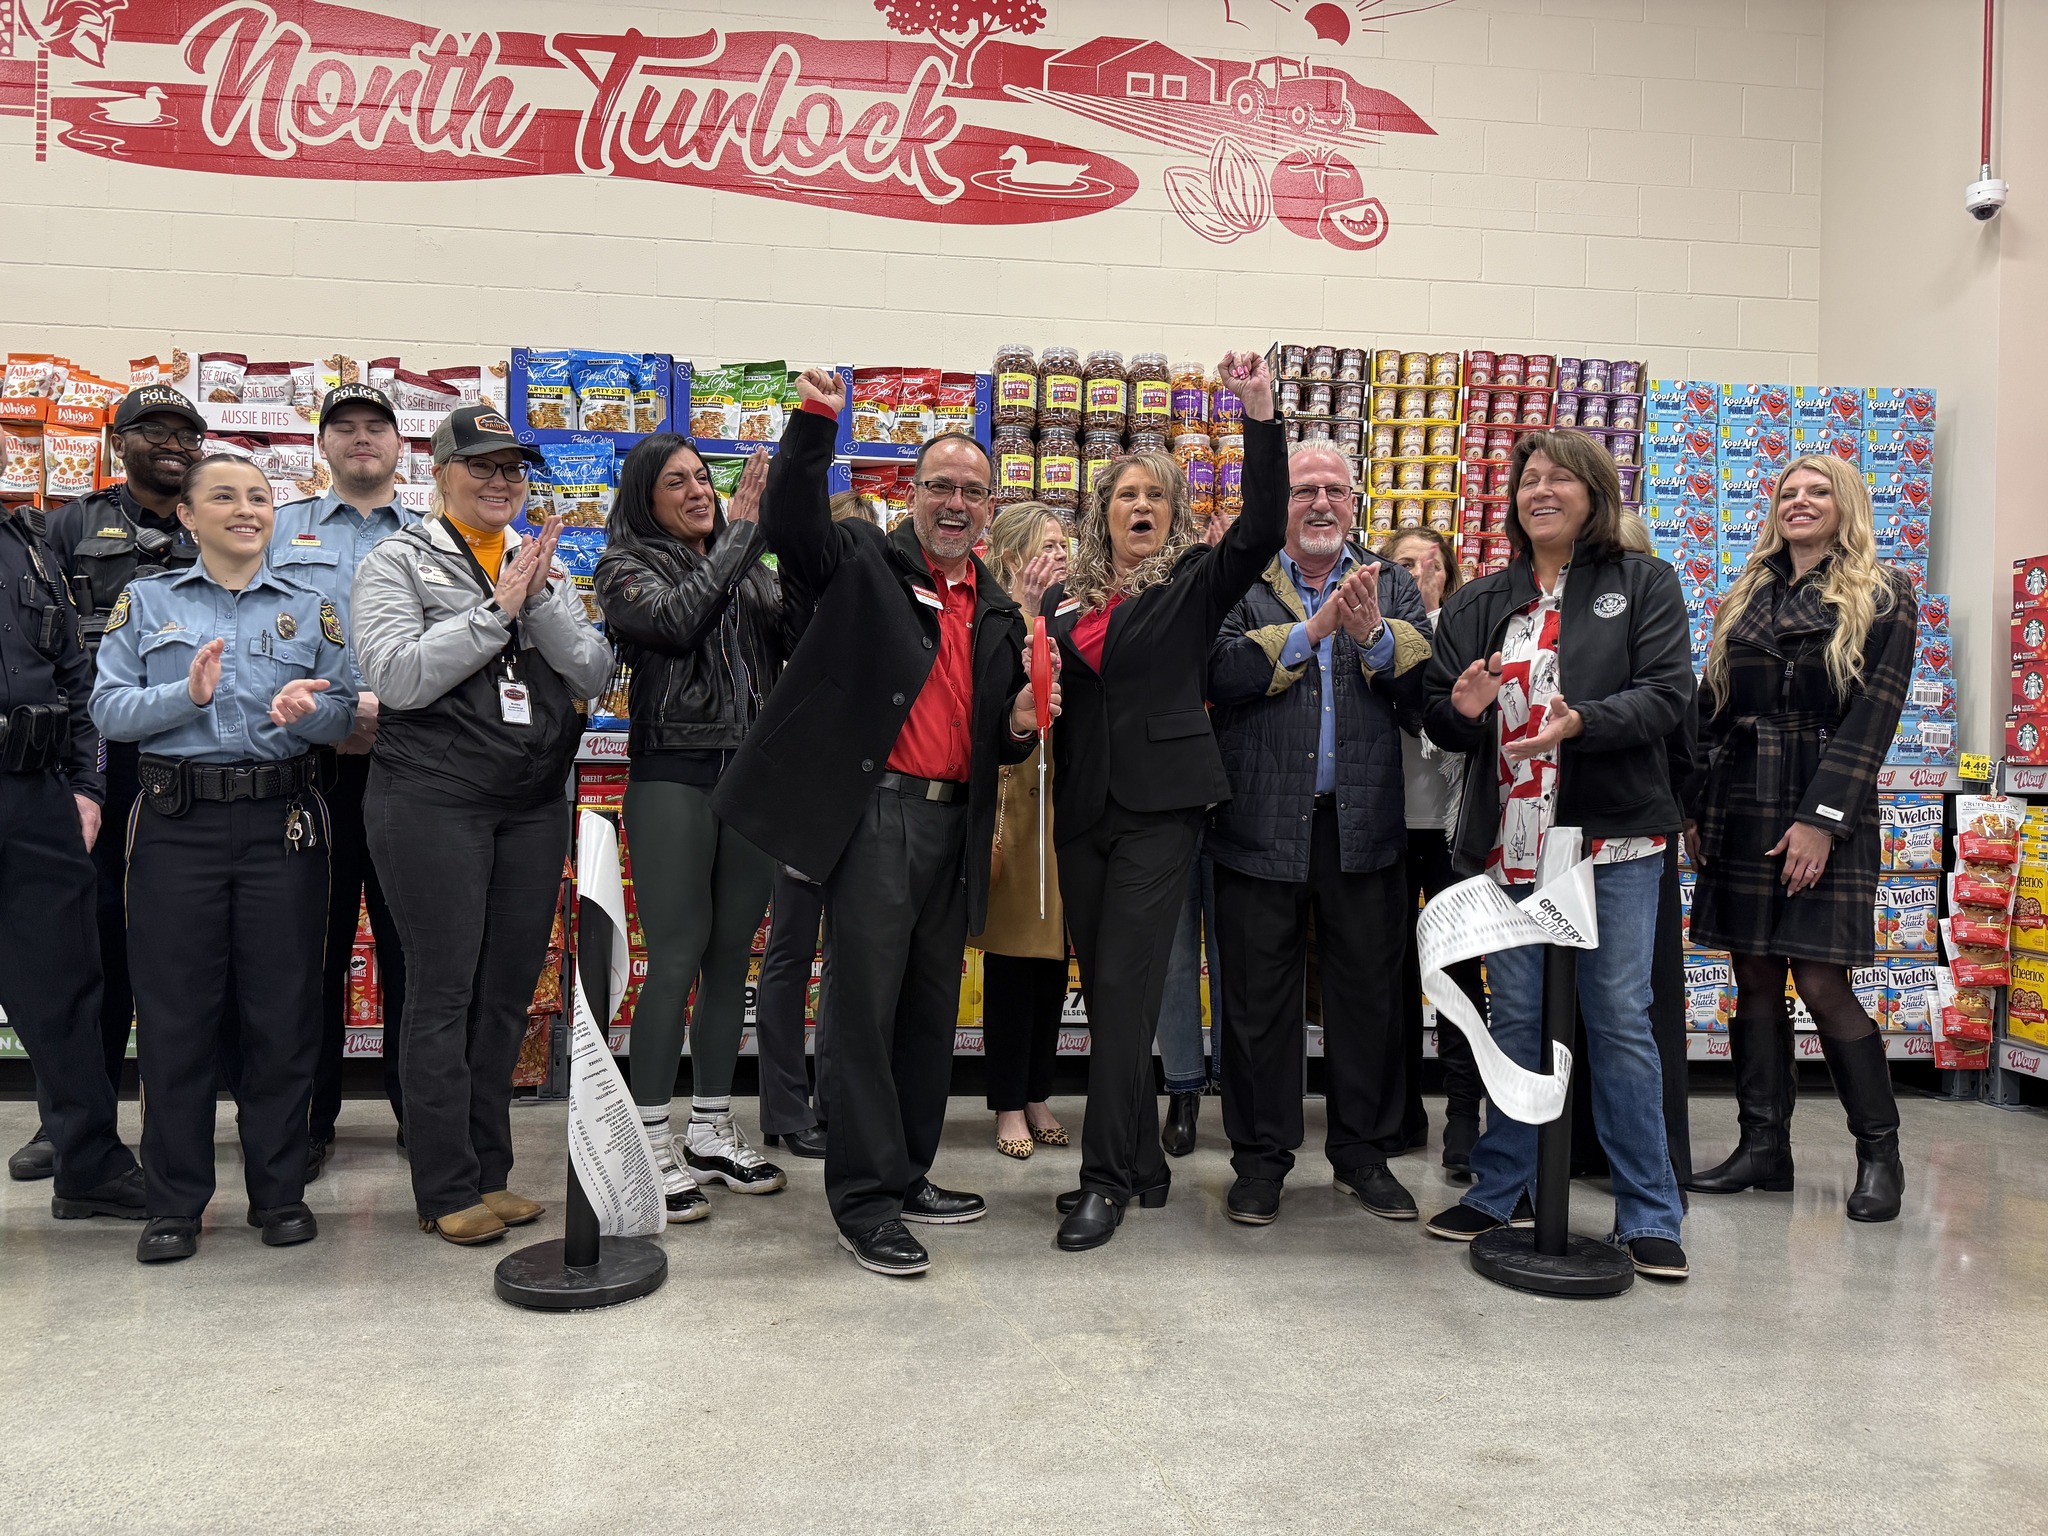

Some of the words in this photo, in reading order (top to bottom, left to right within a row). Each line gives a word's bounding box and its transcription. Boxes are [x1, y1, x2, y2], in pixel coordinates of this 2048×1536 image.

[183, 1, 535, 162] North
[550, 28, 966, 205] Turlock
[10, 364, 47, 378] Whisps
[214, 370, 237, 384] BITES
[369, 378, 389, 388] BITES
[141, 391, 188, 405] POLICE
[263, 387, 285, 398] BITES
[333, 388, 379, 401] POLICE
[1650, 392, 1688, 402] Kool-Aid
[428, 401, 451, 412] BITES
[1722, 397, 1761, 407] Kool-Aid
[1794, 399, 1832, 409] Kool-Aid
[1868, 400, 1906, 410] Kool-Aid
[58, 408, 94, 422] Whisps
[221, 410, 258, 425] AUSSIE
[261, 413, 289, 426] BITES
[398, 418, 425, 432] USSIE
[53, 438, 96, 453] Whisps
[1648, 435, 1686, 445] Kool-Aid
[1720, 439, 1760, 449] Kool-Aid
[1794, 441, 1831, 451] Kool-Aid
[1868, 442, 1905, 452] Kool-Aid
[280, 454, 309, 467] AUSSIE
[52, 474, 90, 485] POPPED
[1649, 477, 1688, 487] Kool-Aid
[1722, 480, 1760, 491] Kool-Aid
[272, 487, 289, 500] TES
[1649, 519, 1687, 529] Kool-Aid
[1721, 523, 1759, 532] Kool-Aid
[1722, 564, 1746, 574] Kool-
[2015, 601, 2024, 609] 64
[1892, 734, 1923, 745] Kool-Ai
[1961, 760, 1987, 771] $4.49
[581, 775, 602, 783] CHEEZ-IT
[1910, 769, 1949, 787] Wow!
[2014, 770, 2046, 789] Wow!
[1898, 807, 1942, 824] Welch's
[1907, 838, 1932, 848] Snacks
[2016, 874, 2044, 889] heerios
[1893, 888, 1935, 905] Welch's
[1539, 898, 1586, 943] GROCERY
[1901, 918, 1925, 928] Snacks
[1685, 967, 1727, 983] Welch's
[1893, 969, 1935, 986] Welch's
[2012, 965, 2045, 983] Cheerios
[1696, 992, 1714, 1001] Fruit
[1691, 1000, 1716, 1008] Snacks
[1901, 1000, 1926, 1009] Snacks
[1057, 1032, 1089, 1052] Wow!
[1904, 1037, 1934, 1055] Wow
[2008, 1050, 2040, 1073] Wow!
